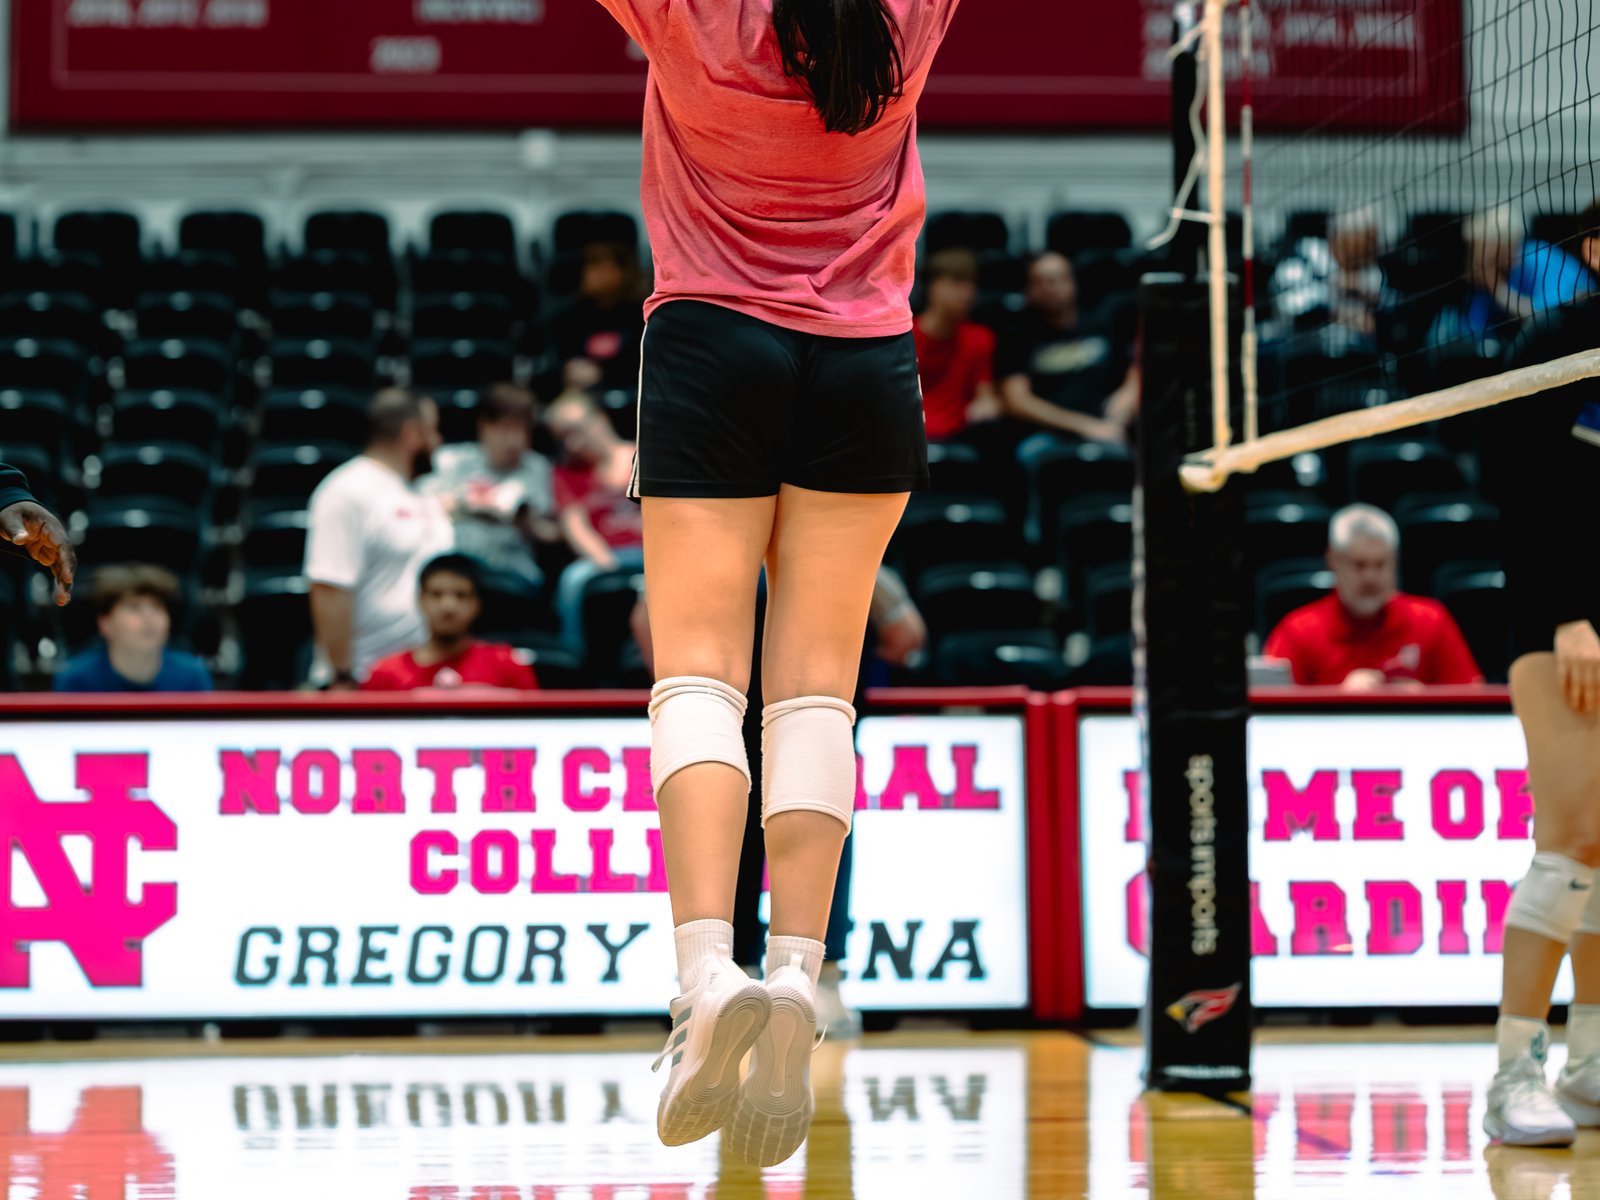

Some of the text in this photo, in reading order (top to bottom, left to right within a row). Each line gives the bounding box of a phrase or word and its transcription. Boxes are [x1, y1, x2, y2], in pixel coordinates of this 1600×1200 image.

[218, 748, 537, 814] NORTH
[1183, 754, 1220, 956] sports imports
[234, 923, 650, 986] GREGORY
